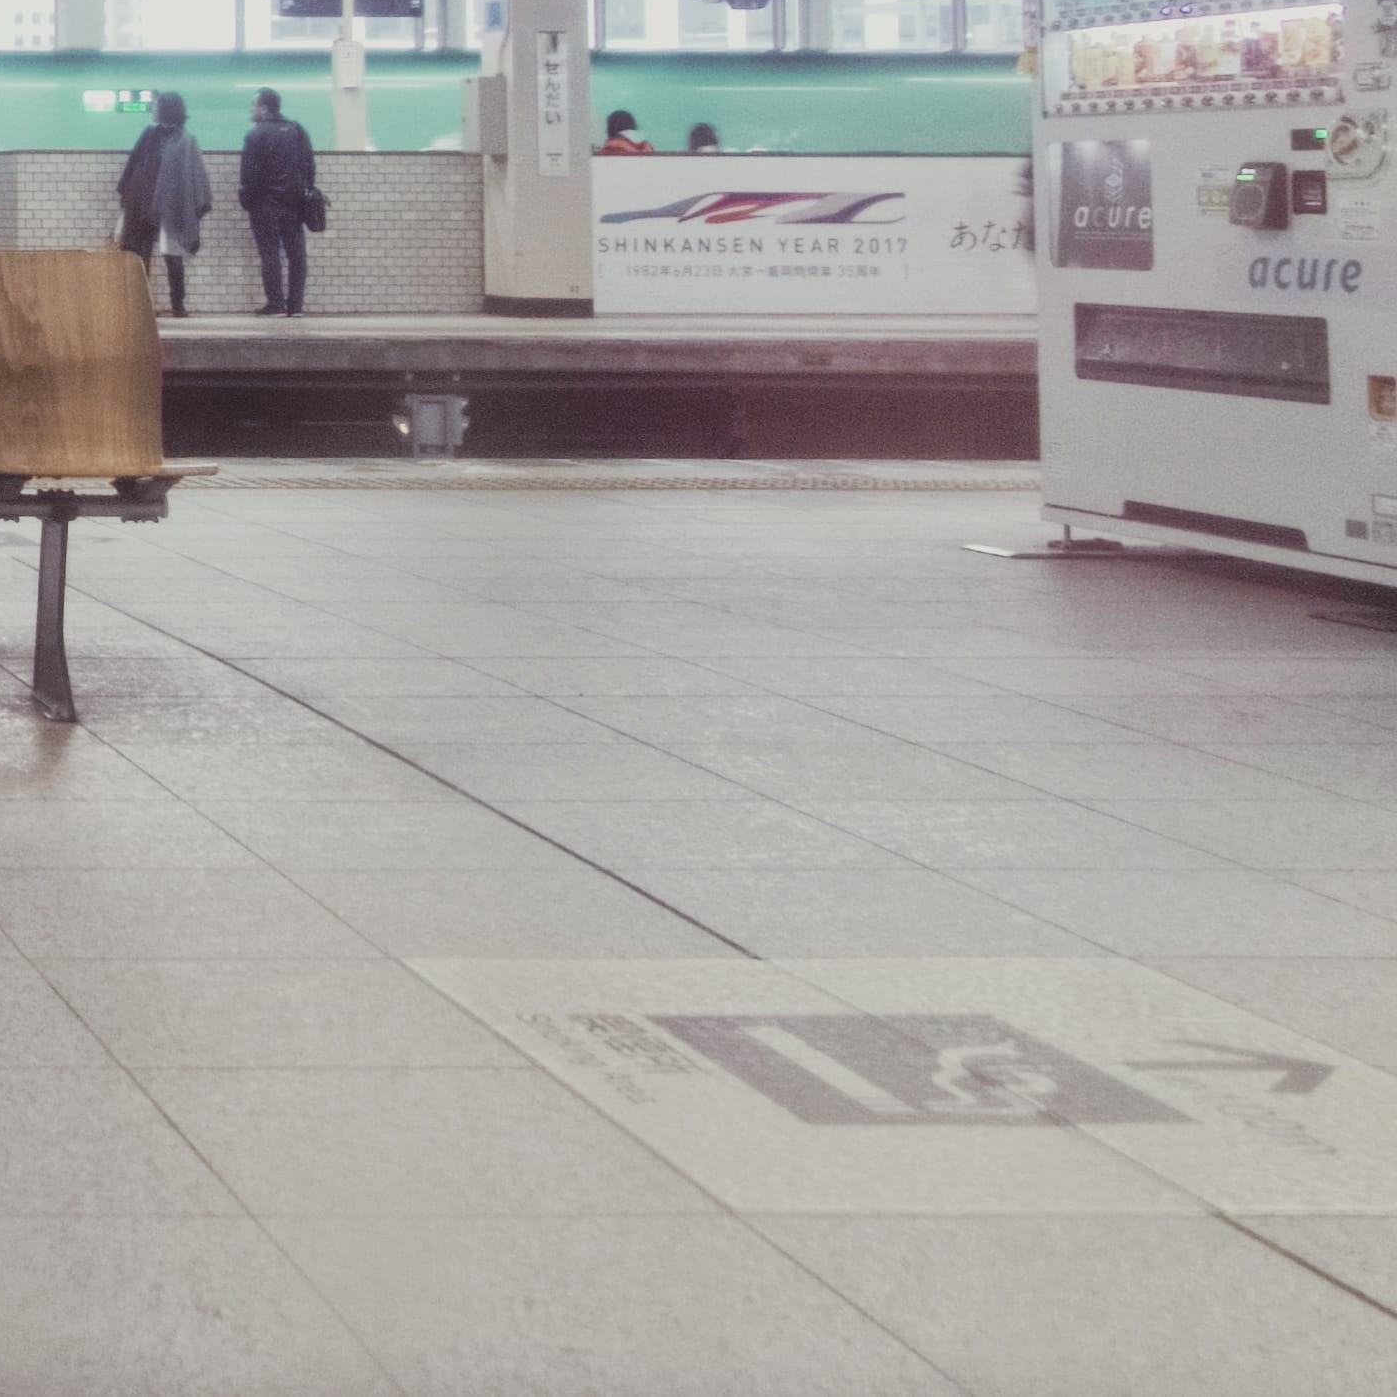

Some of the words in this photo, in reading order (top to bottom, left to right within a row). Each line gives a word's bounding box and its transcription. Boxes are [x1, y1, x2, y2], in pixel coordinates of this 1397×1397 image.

[1074, 205, 1152, 230] acure
[598, 237, 764, 254] SHINKANSEN
[776, 238, 841, 254] YEAR
[853, 238, 909, 254] 2017
[1248, 256, 1363, 294] acure
